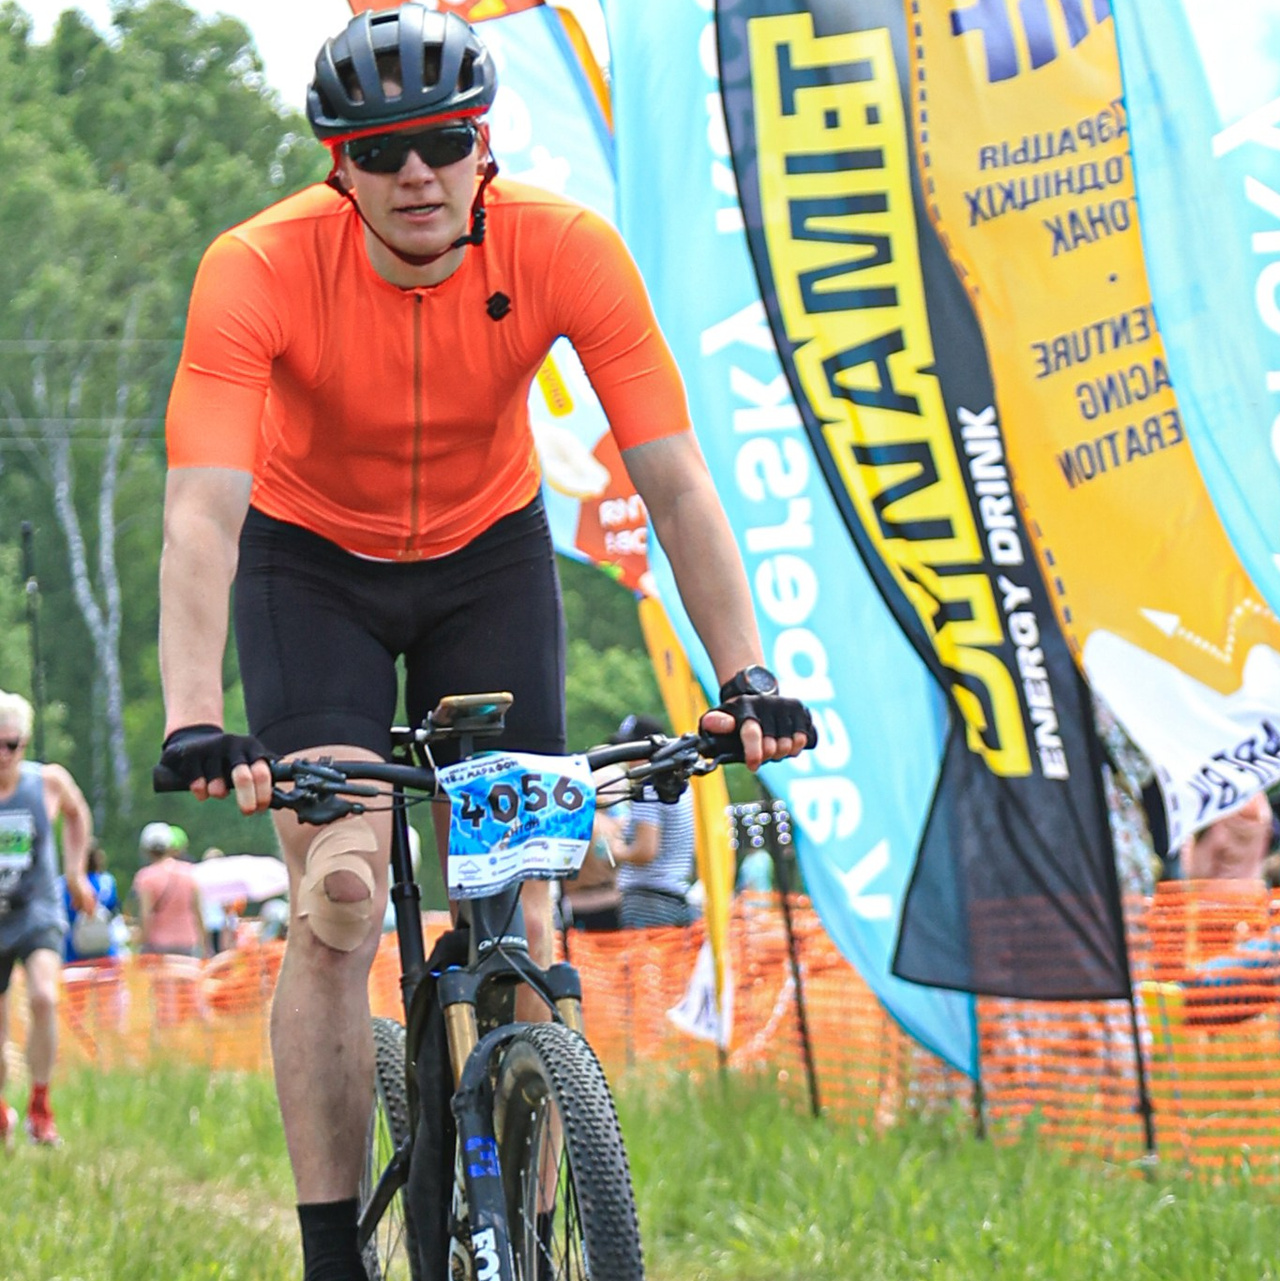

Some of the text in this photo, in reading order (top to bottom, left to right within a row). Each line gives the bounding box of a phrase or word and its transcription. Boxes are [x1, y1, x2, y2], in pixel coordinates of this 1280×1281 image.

[958, 406, 1069, 780] ENERGY DRINK
[459, 774, 584, 828] 4056
